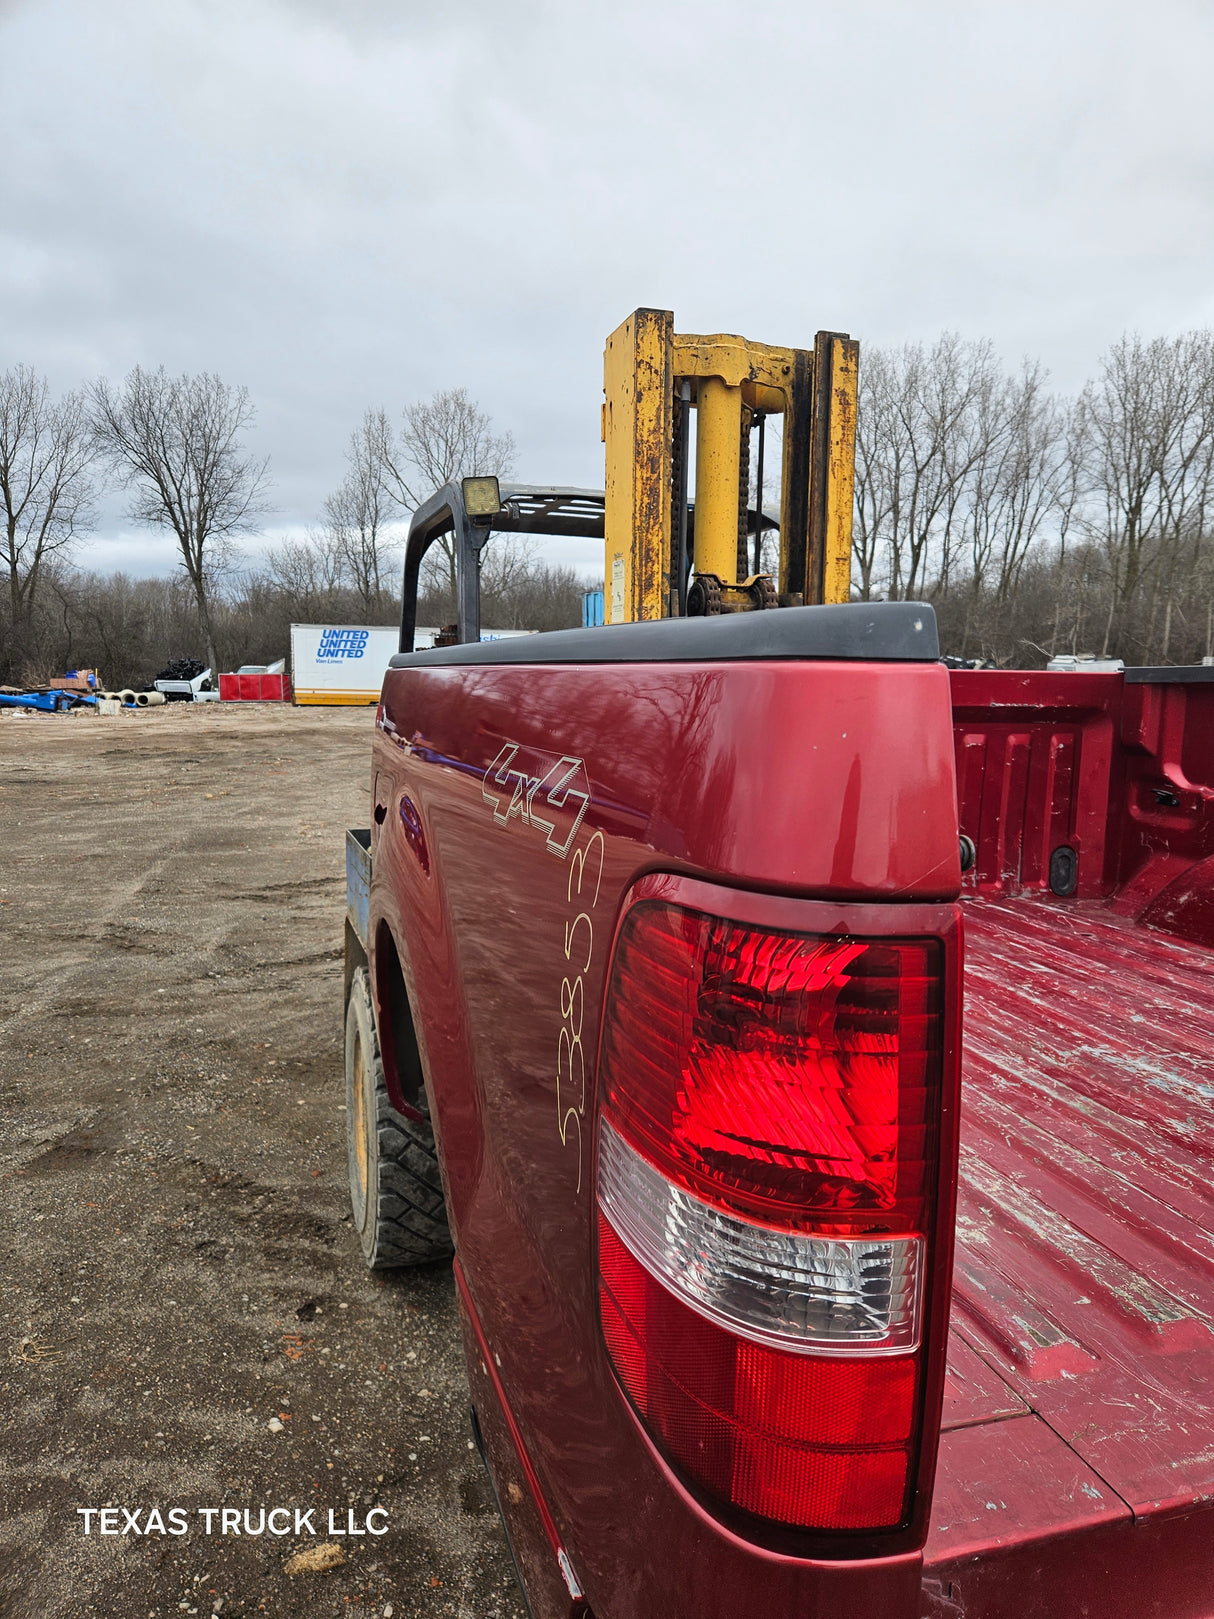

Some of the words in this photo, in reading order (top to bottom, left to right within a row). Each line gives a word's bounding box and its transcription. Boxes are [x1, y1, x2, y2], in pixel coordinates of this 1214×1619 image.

[322, 629, 369, 639] UNITED
[320, 639, 367, 649] UNITED
[317, 648, 364, 658] UNITED
[556, 830, 604, 1195] 53853
